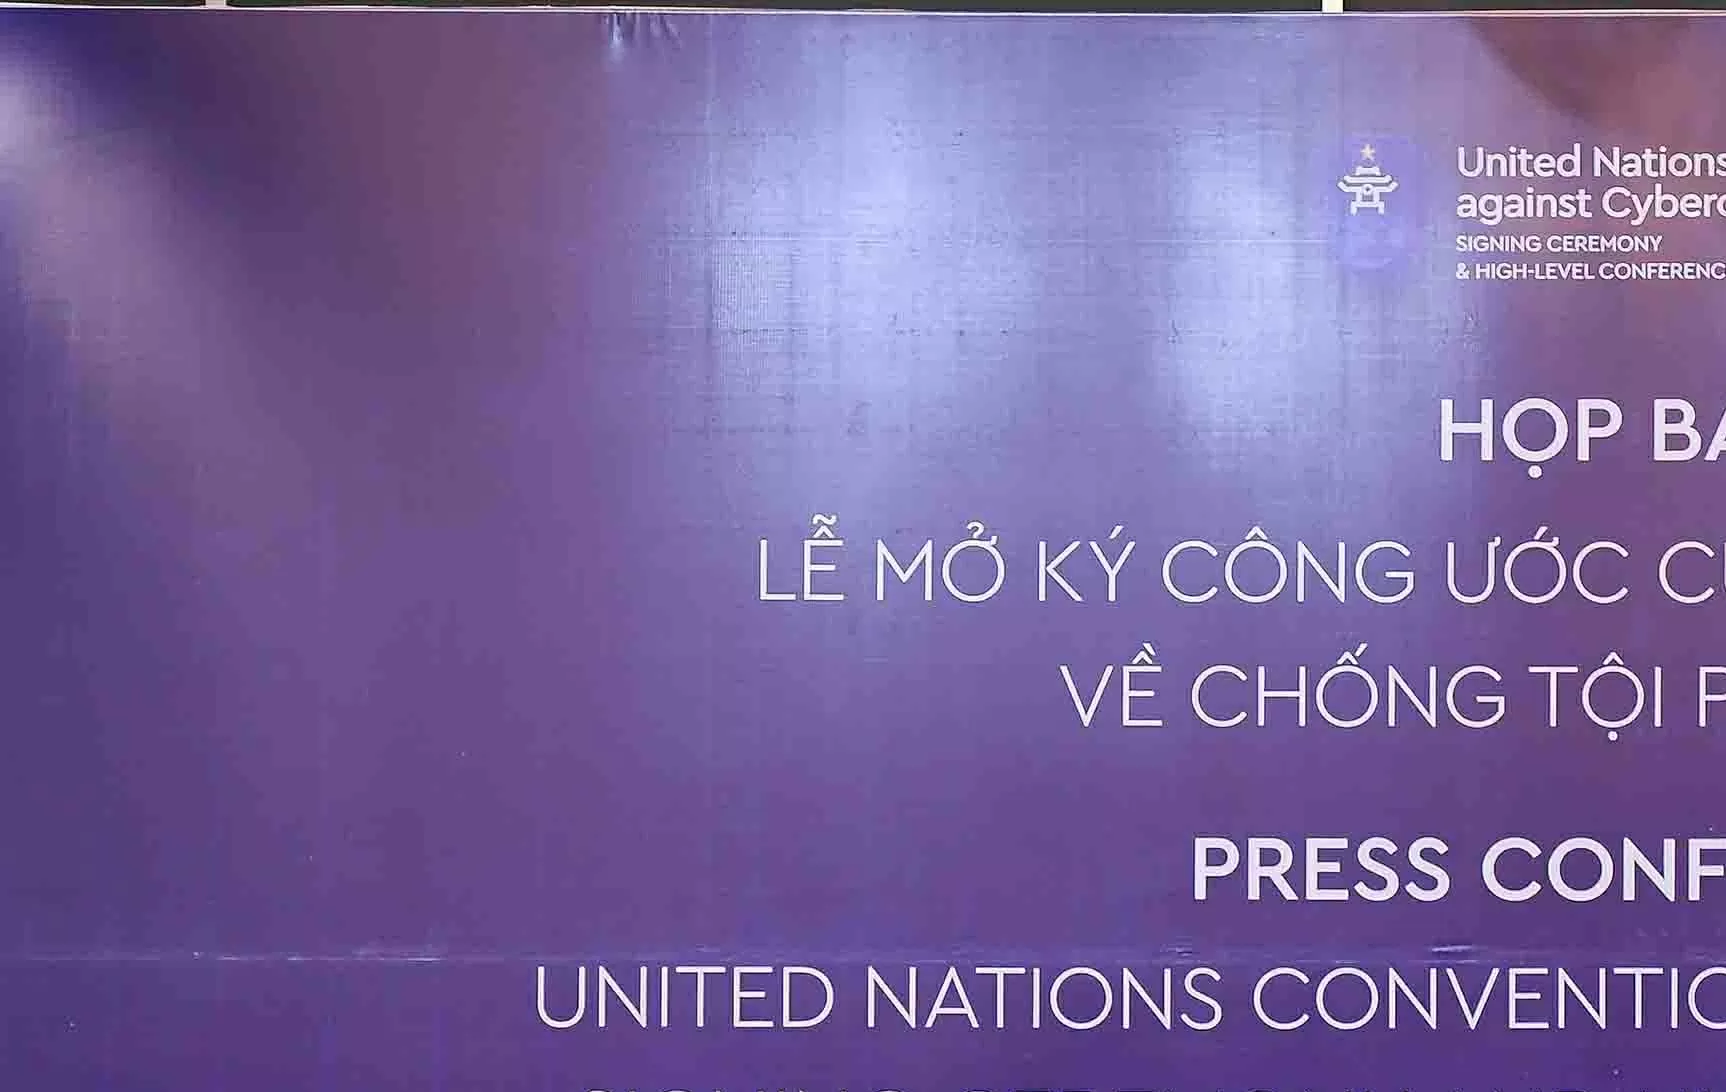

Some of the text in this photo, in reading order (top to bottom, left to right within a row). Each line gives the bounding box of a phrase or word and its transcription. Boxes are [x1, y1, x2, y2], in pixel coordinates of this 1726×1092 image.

[1457, 143, 1581, 177] United
[1456, 186, 1593, 225] against
[1455, 234, 1663, 253] SIGNING CEREMONY
[1455, 262, 1471, 280] &
[1475, 262, 1596, 280] HIGH-LEVEL
[1440, 398, 1623, 479] HỌP
[759, 513, 845, 602] LỄ
[876, 521, 1005, 604] MỞ
[1038, 525, 1136, 602] KÝ
[1162, 526, 1415, 605] CÔNG
[1447, 525, 1629, 605] ƯỚC
[1060, 642, 1164, 728] VỀ
[1191, 642, 1506, 729] CHỐNG
[1528, 652, 1662, 741] TỘI
[1194, 836, 1451, 902] PRESS
[536, 966, 834, 1029] UNITED
[867, 966, 1223, 1031] NATIONS
